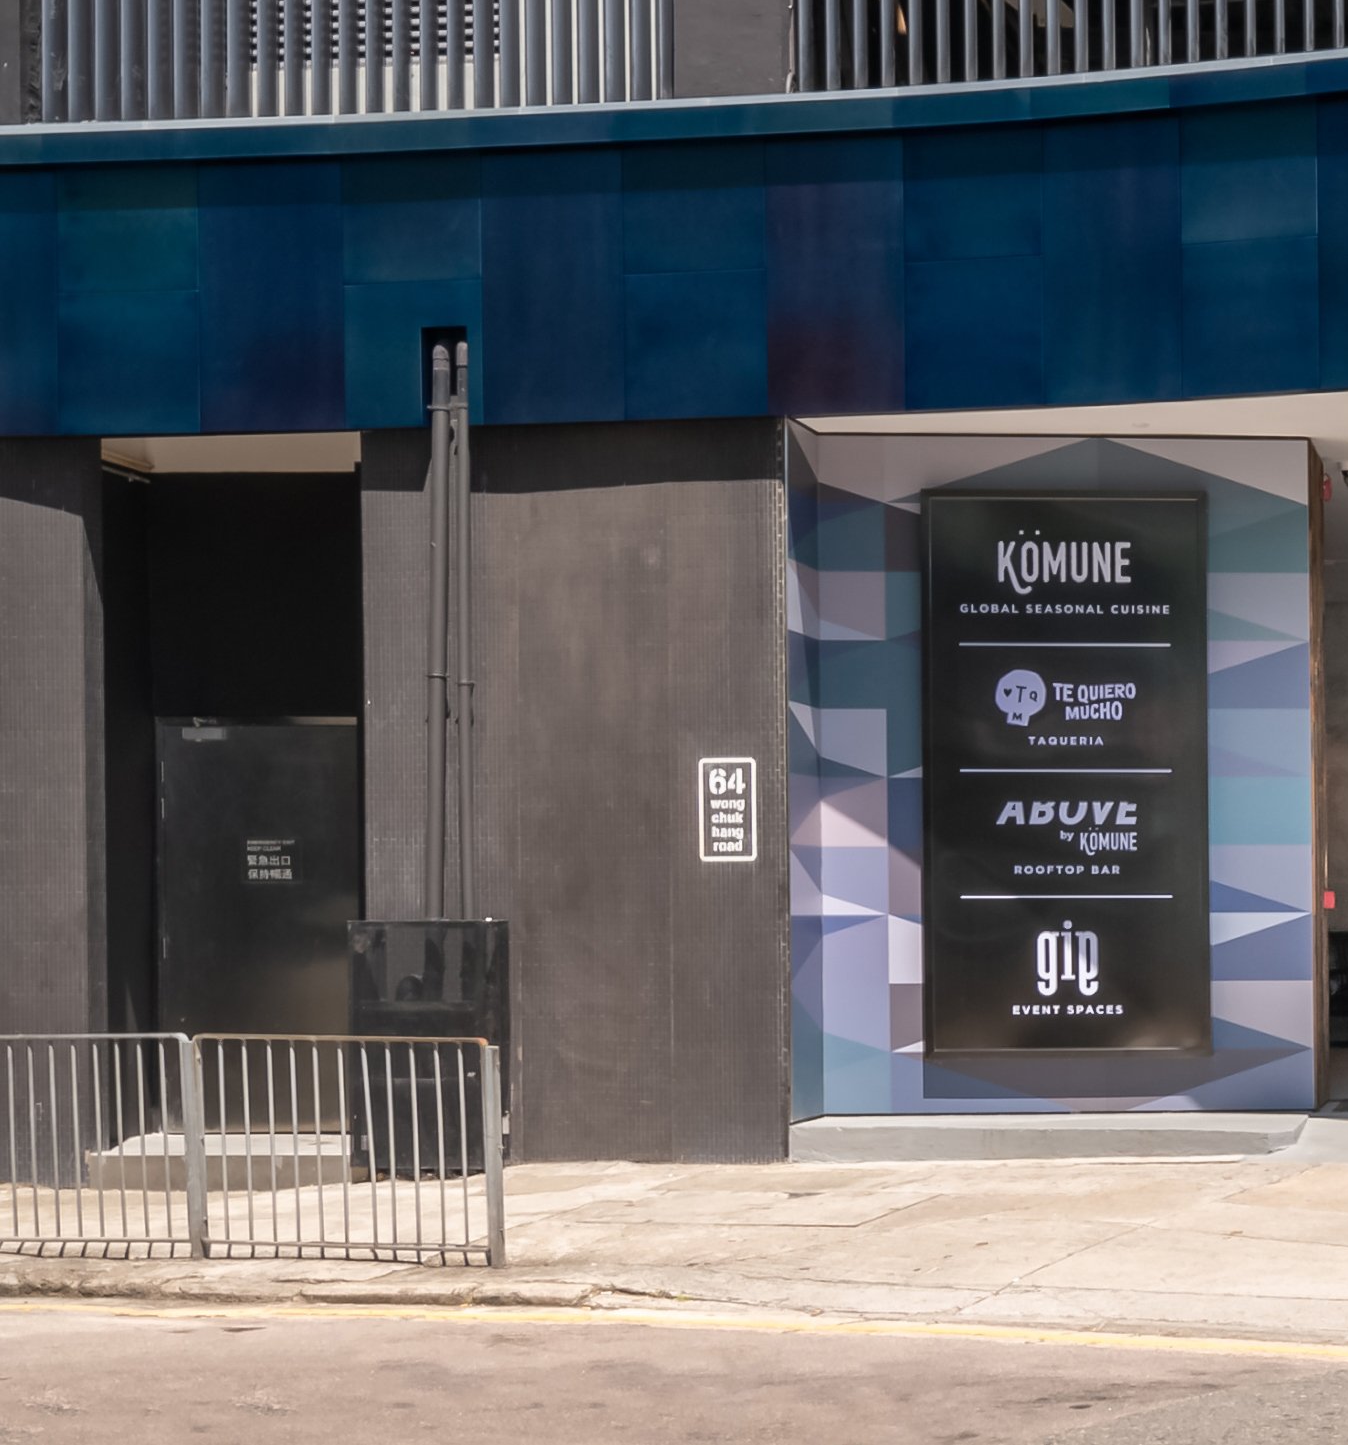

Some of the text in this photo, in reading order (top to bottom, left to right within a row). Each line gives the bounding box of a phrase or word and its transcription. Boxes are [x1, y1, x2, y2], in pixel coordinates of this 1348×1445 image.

[998, 529, 1132, 594] KÖMUNE
[959, 603, 1170, 615] GLOBAL SEASONAL CUISINE
[1053, 682, 1136, 704] TE QUIERO
[1065, 701, 1123, 721] MUCHO
[1028, 735, 1104, 746] TAQUERIA
[708, 767, 746, 795] 64
[710, 799, 746, 812] wong
[711, 812, 744, 823] chuk
[711, 826, 744, 839] hang
[1060, 830, 1075, 842] by
[713, 840, 743, 852] road
[1014, 864, 1121, 875] ROOFTOP BAR
[1012, 1004, 1124, 1015] EVENT SPACES
